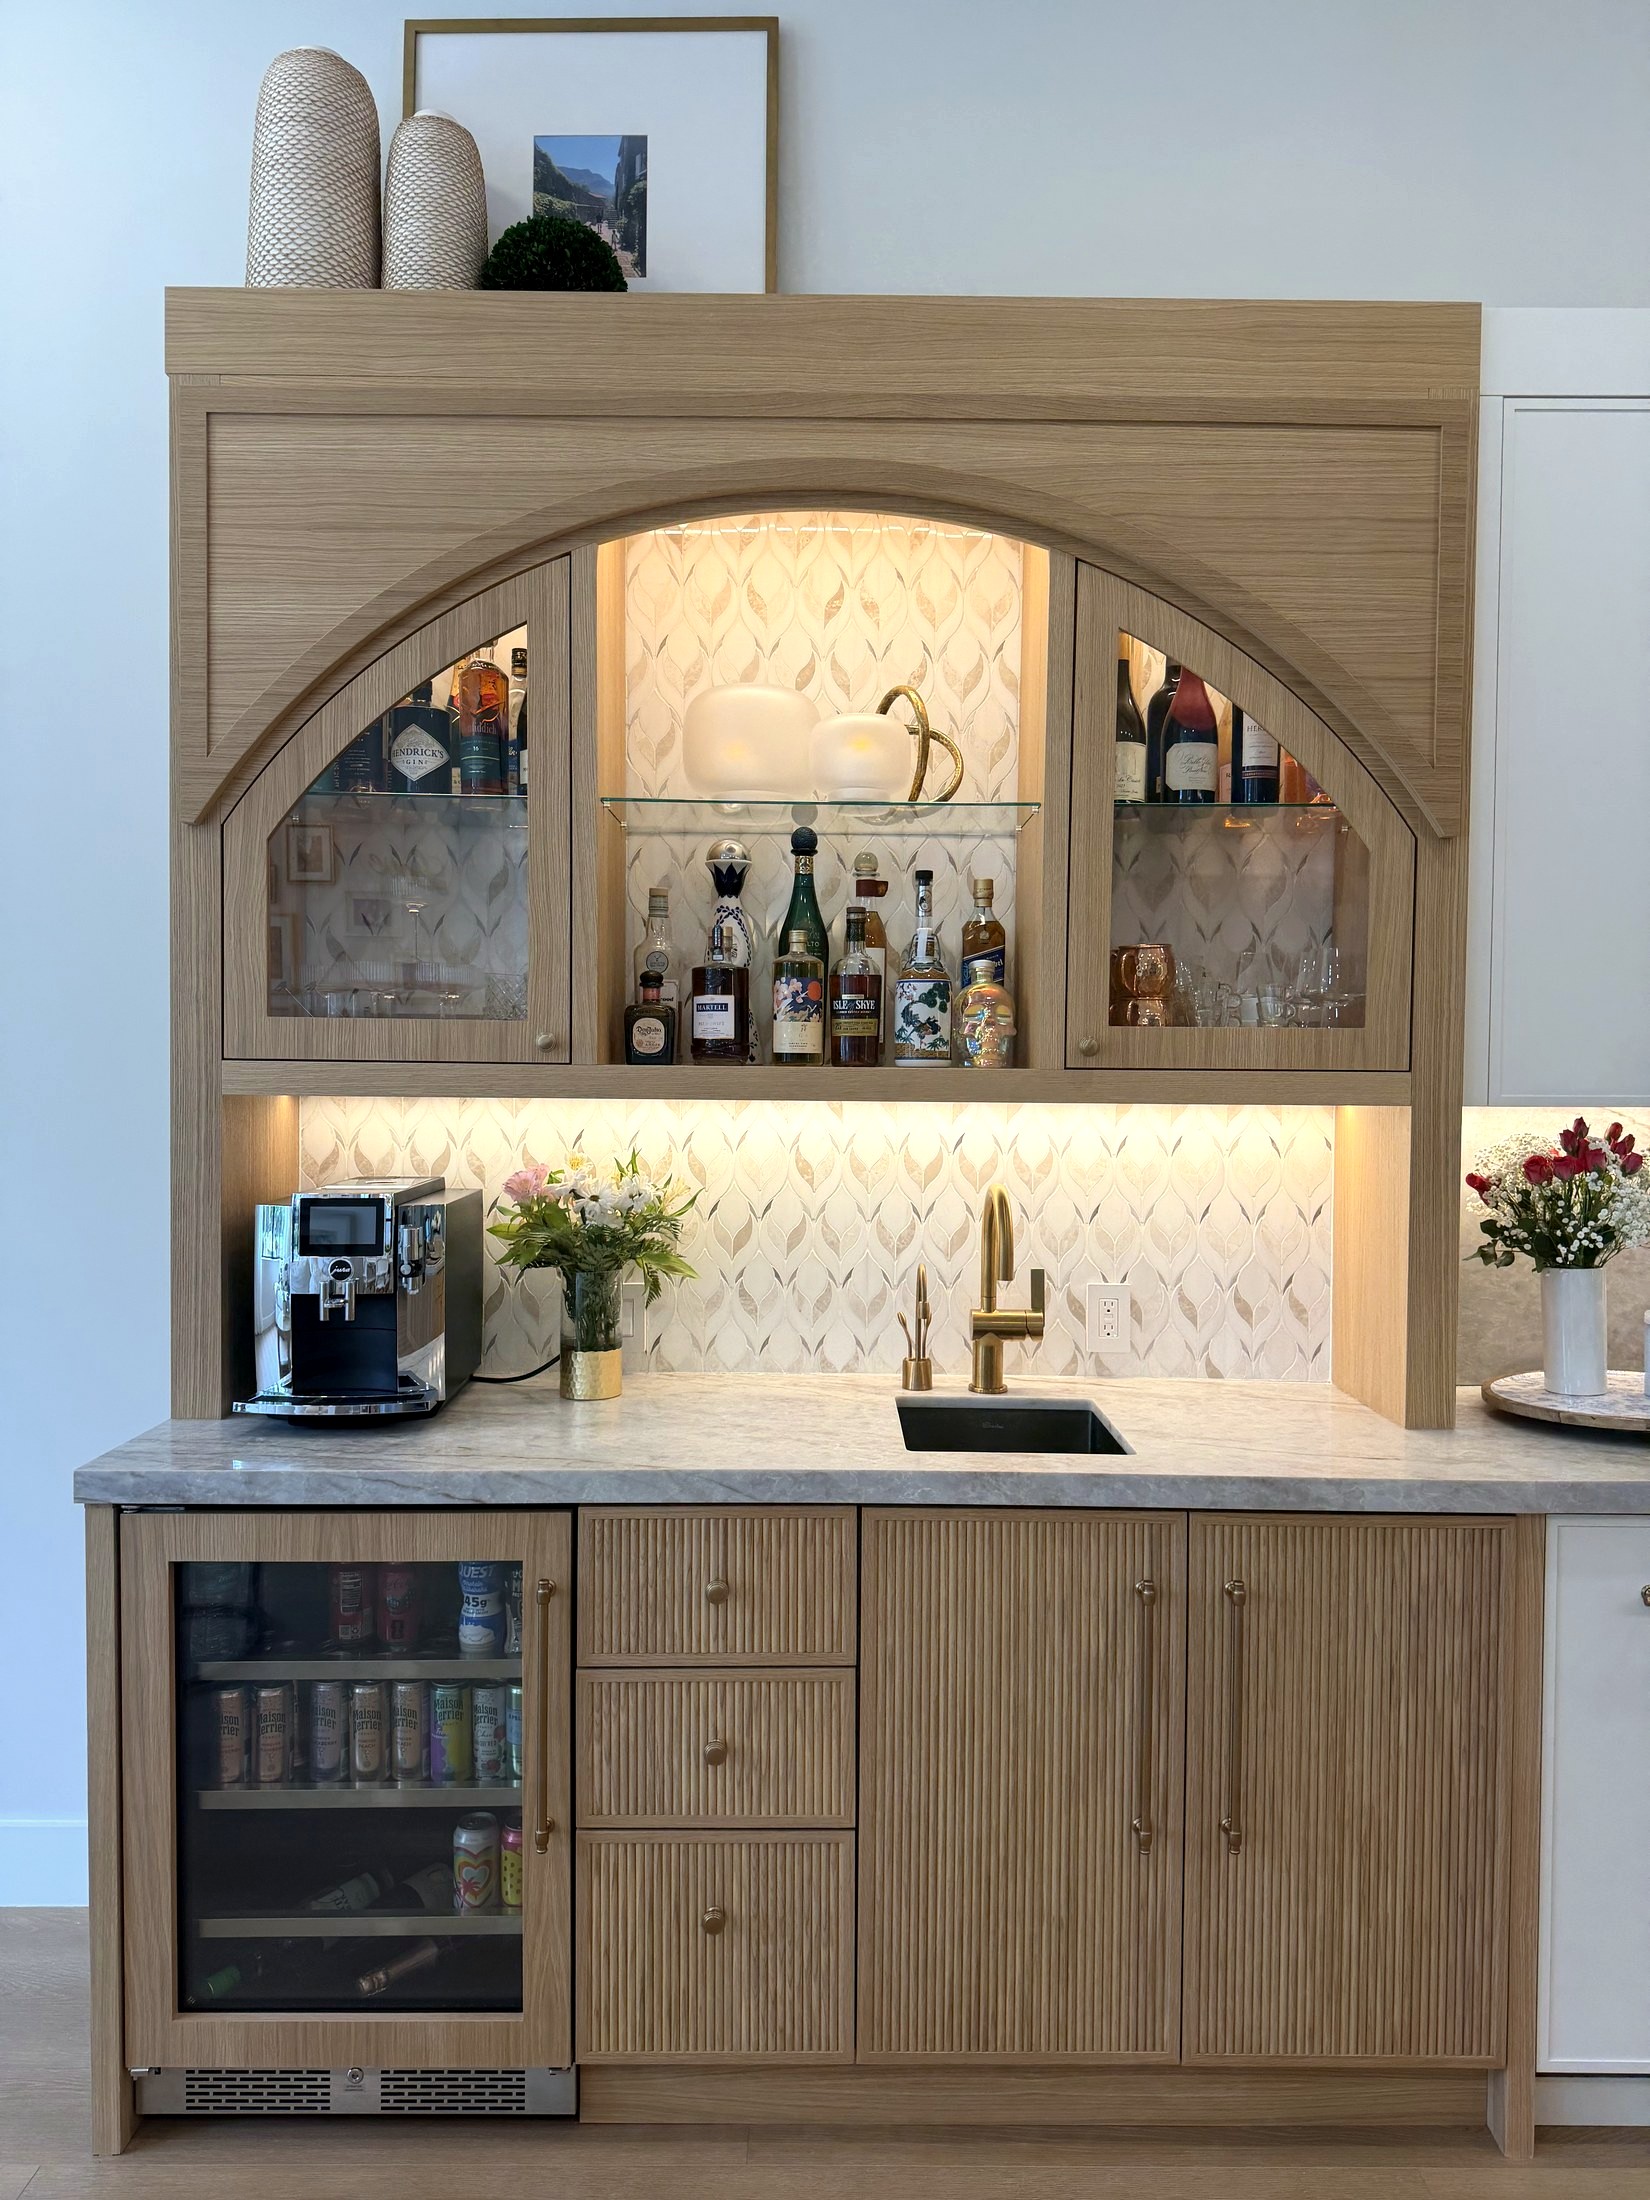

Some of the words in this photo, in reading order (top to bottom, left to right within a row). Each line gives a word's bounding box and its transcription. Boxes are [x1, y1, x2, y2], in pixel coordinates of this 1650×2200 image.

[392, 748, 445, 759] HENDRICK'S
[855, 1000, 876, 1010] SKYE
[459, 1562, 497, 1578] QUEST
[464, 1595, 487, 1608] 45g
[433, 1697, 464, 1711] Maison
